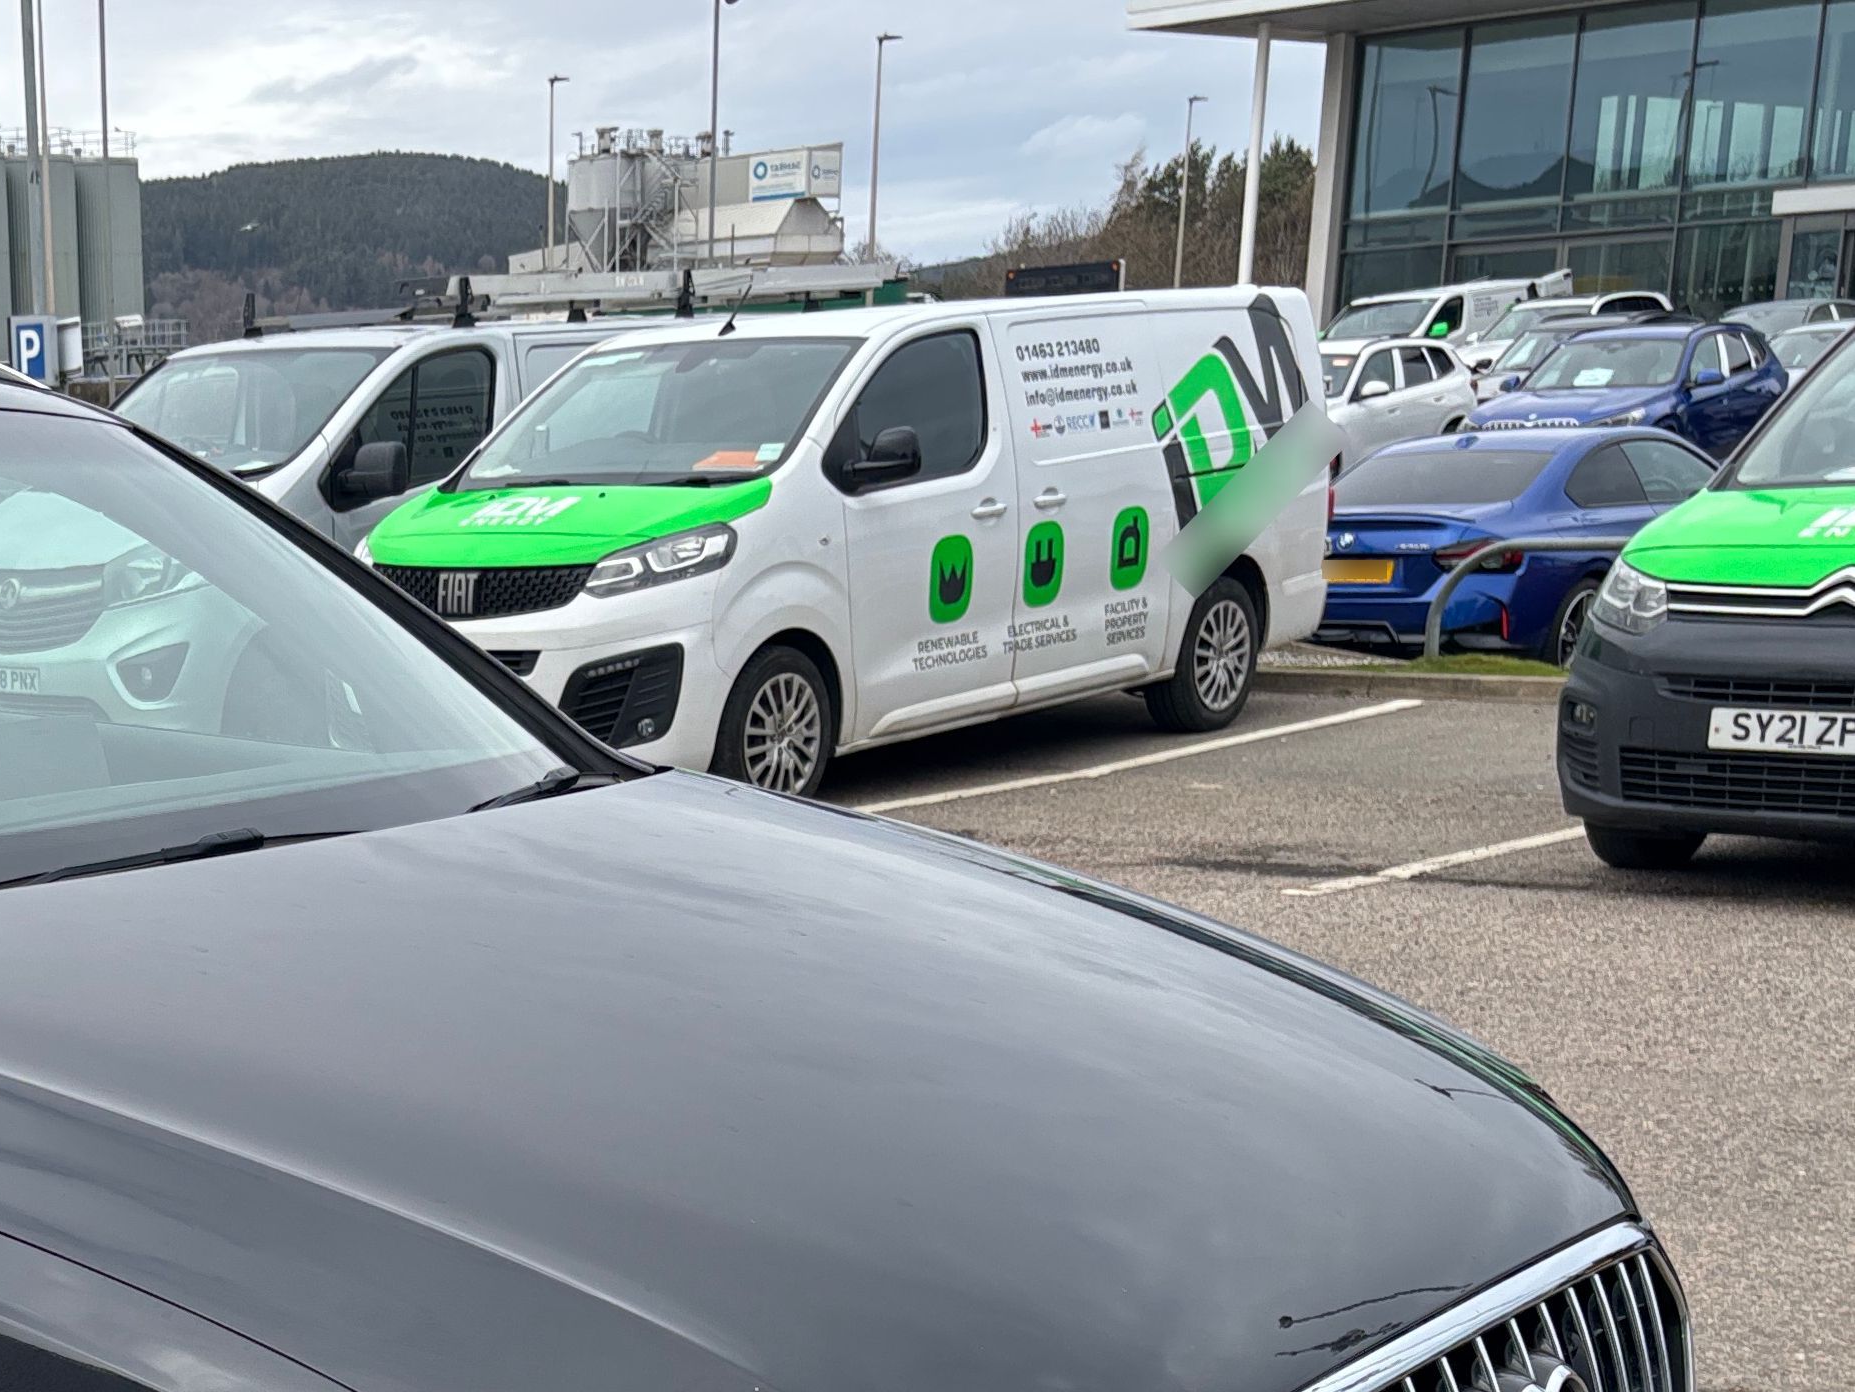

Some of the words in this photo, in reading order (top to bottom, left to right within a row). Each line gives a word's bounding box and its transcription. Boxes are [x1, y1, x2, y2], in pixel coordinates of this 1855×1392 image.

[20, 329, 41, 374] P
[1015, 342, 1055, 361] 01463
[1056, 338, 1100, 357] 213480
[1021, 357, 1133, 382] www.idmenergy.co.uk
[1025, 380, 1137, 407] info@idmenergy.co.uk
[437, 572, 480, 615] FIAT
[1104, 598, 1141, 616] FACILITY
[1142, 597, 1148, 610] &
[1007, 617, 1062, 639] ELECTRICAL
[1062, 615, 1069, 628] &
[1104, 611, 1148, 632] PROPERTY
[917, 631, 979, 655] RENEWABLE
[1003, 637, 1034, 655] TRADE
[1035, 629, 1077, 651] SERVICES
[1106, 626, 1146, 646] SERVICES
[912, 645, 988, 672] TECHNOLOGIES
[11, 671, 37, 691] PNX
[1731, 712, 1807, 745] SY21
[1816, 714, 1855, 747] ZP
